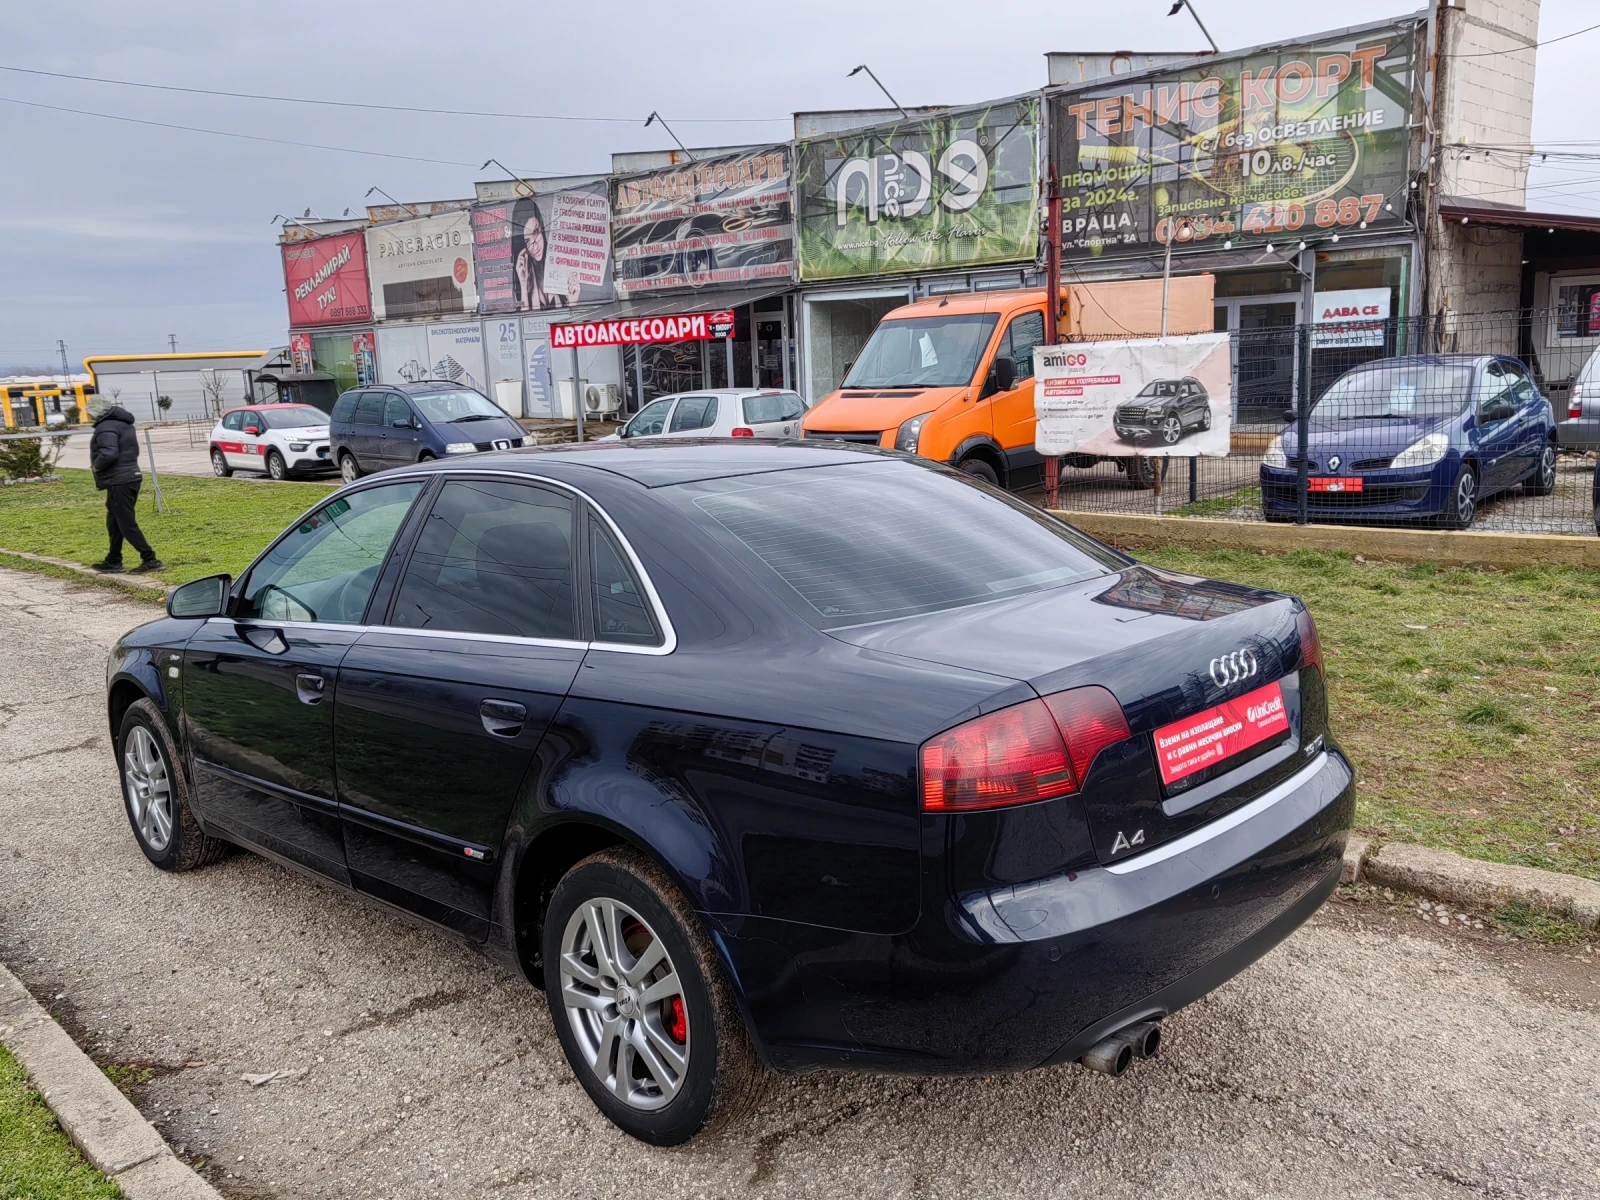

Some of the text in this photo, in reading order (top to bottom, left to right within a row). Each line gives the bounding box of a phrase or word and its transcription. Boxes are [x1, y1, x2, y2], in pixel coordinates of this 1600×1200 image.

[1069, 44, 1387, 140] ТЕНИС КОРТ
[1258, 109, 1385, 141] ОСВЕТЛЕНИЕ
[616, 152, 784, 209] АВТОАКСЕСОАРИ
[1061, 163, 1152, 188] ПРОМОЦИЯ
[587, 198, 606, 208] УСЛУГИ
[1062, 187, 1139, 214] за 2024г.
[1157, 187, 1304, 217] записване на часове:
[586, 211, 607, 222] ДИЗАЙН
[1063, 212, 1138, 234] ВРАЦА,
[1155, 193, 1384, 245] 0894 420 887
[582, 223, 606, 235] РЕКЛАМА
[743, 228, 778, 241] КСЕНОНИ
[837, 224, 987, 251] www.nice.bg Follow the Flavor
[379, 230, 461, 258] PANCRACIO
[478, 243, 512, 261] РЕКЛАМА
[554, 244, 605, 260] РЕКЛАМНИ СУВЕНИРИ
[580, 236, 604, 248] РЕКЛАМА
[294, 243, 351, 302] РЕКЛАМИРАЙ
[398, 257, 443, 269] ARTISAN CHOCOLATE
[555, 256, 601, 271] ФИРМЕНИ ПЕЧАТИ
[579, 272, 601, 284] ТЕНИСКИ
[317, 285, 337, 310] ТУК!
[330, 304, 368, 317] 0897 888 333
[1322, 305, 1380, 319] ДАВА СЕ
[431, 326, 480, 336] ВИСОКОТЕХНОЛОГИЧНИ
[455, 336, 480, 344] МАТЕРИАЛИ
[499, 322, 517, 342] 25
[554, 316, 706, 346] АВТОАКСЕСОАРИ
[1043, 352, 1087, 367] amiGO
[1076, 376, 1119, 385] УПОТРЕБЯВАНИ
[1045, 388, 1083, 396] АВТОМОБИЛИ
[1254, 696, 1283, 719] UniCredit
[1159, 715, 1224, 749] Вземи на изплащане
[1166, 721, 1243, 760] и с равни месечни вноски
[1169, 761, 1187, 774] Защото
[1187, 758, 1198, 766] така
[1200, 749, 1216, 762] удобно
[1111, 829, 1146, 855] A4
